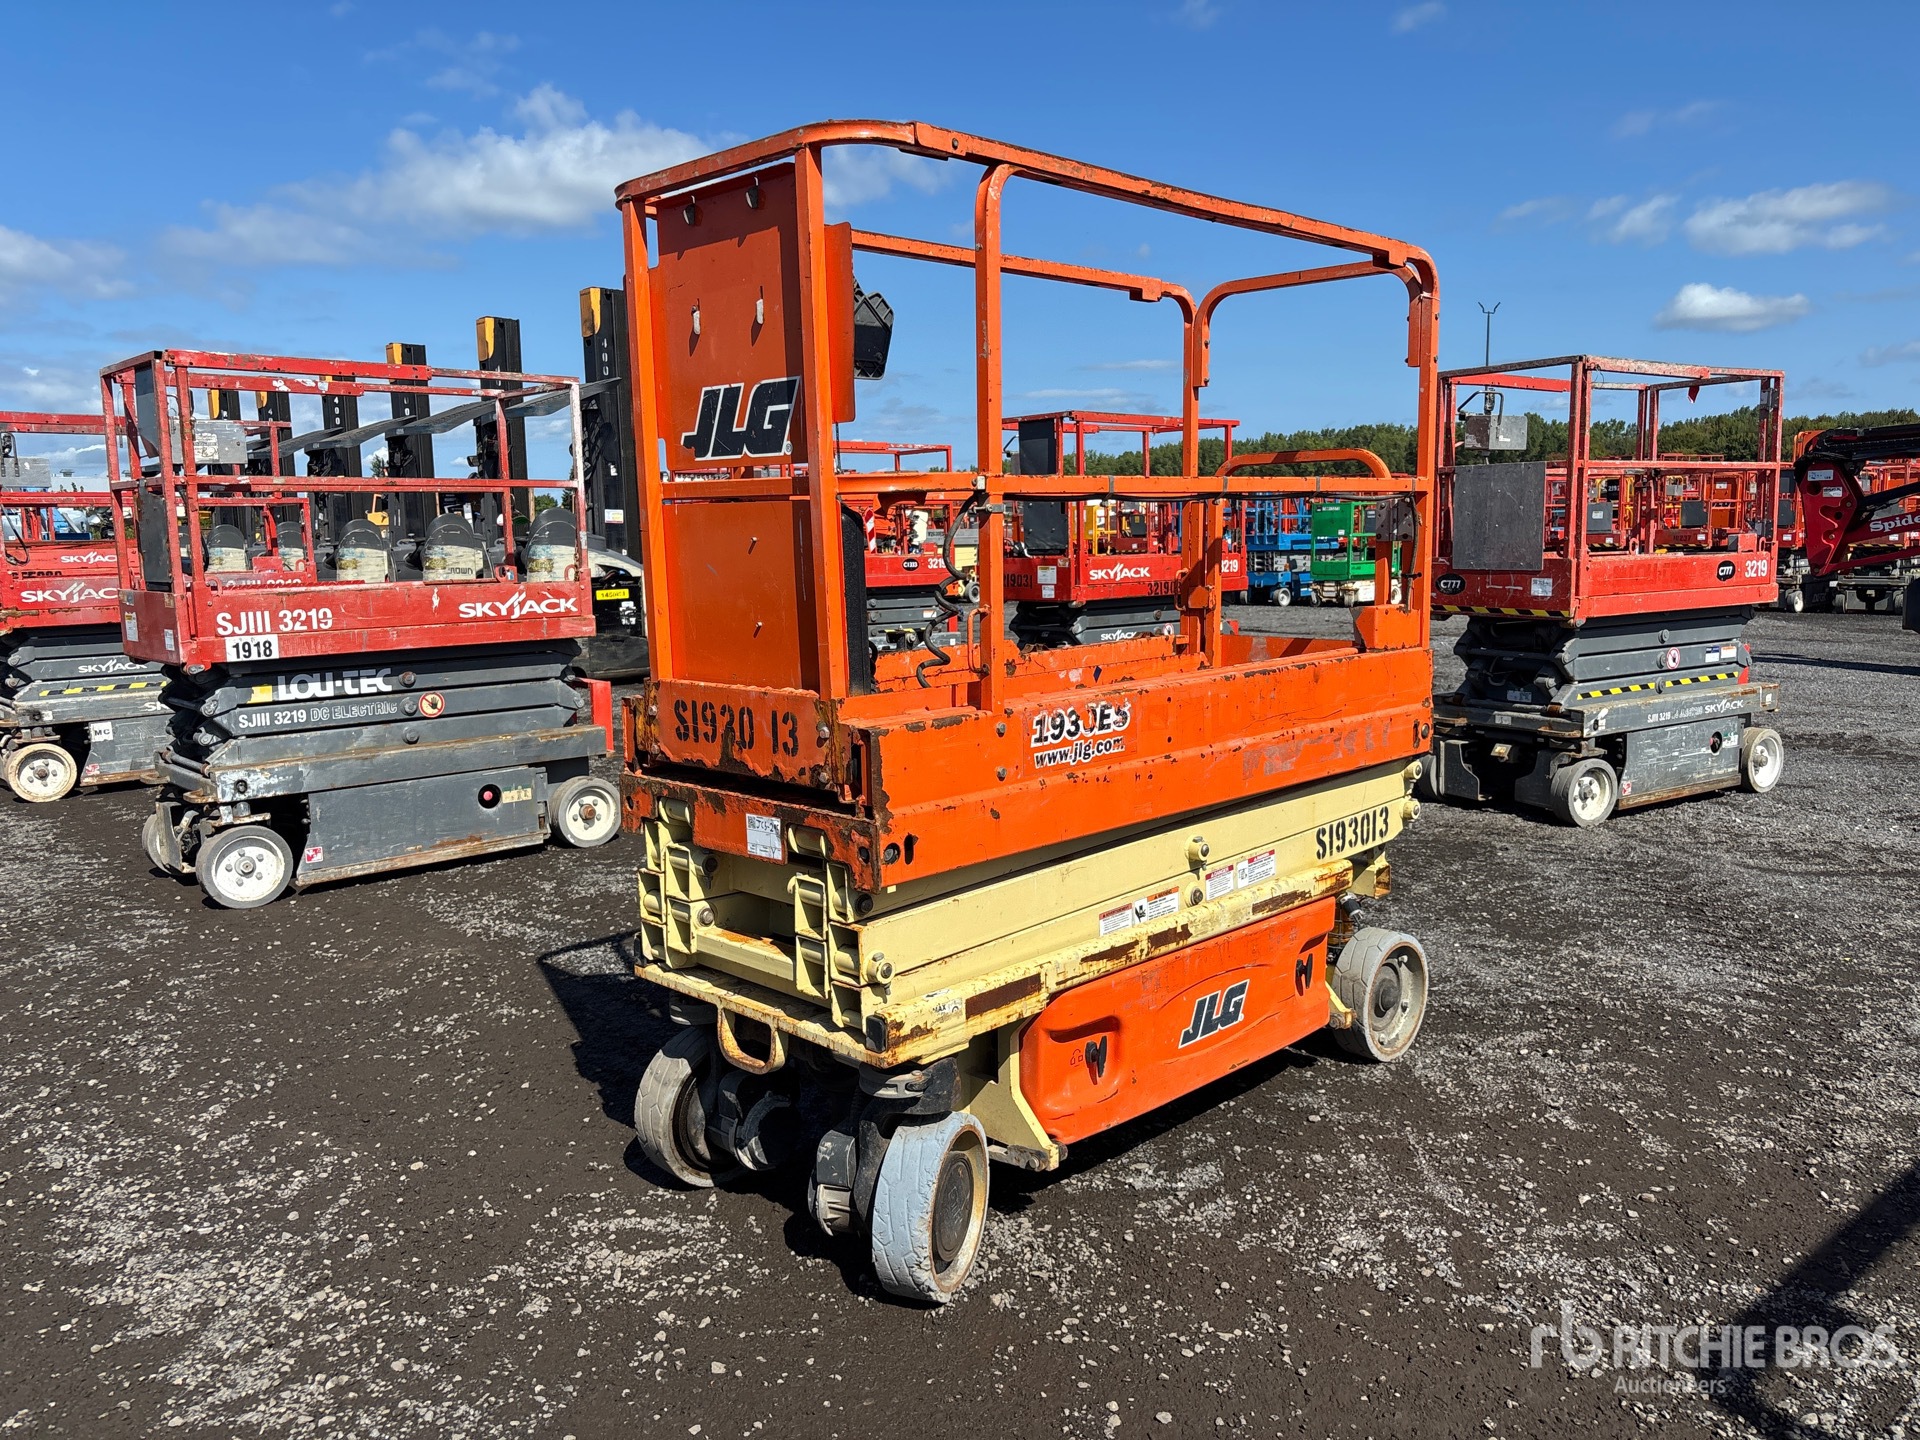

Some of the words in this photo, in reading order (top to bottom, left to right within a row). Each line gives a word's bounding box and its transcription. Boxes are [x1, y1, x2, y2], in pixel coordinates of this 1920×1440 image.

[60, 551, 118, 564] SKYJAC
[1744, 559, 1768, 578] 3219
[1089, 562, 1151, 582] SKYJACK
[20, 582, 119, 604] SKYJAC
[1440, 579, 1461, 589] C777
[458, 588, 579, 620] SKYJACK
[216, 610, 272, 636] SJIII
[278, 607, 333, 632] 3219
[232, 640, 273, 660] 1918
[238, 711, 271, 729] SJIII
[274, 709, 307, 725] 3219
[310, 707, 330, 722] DC
[332, 701, 398, 720] ELECTRIC
[1316, 806, 1389, 860] S193013
[1178, 978, 1250, 1049] JLG
